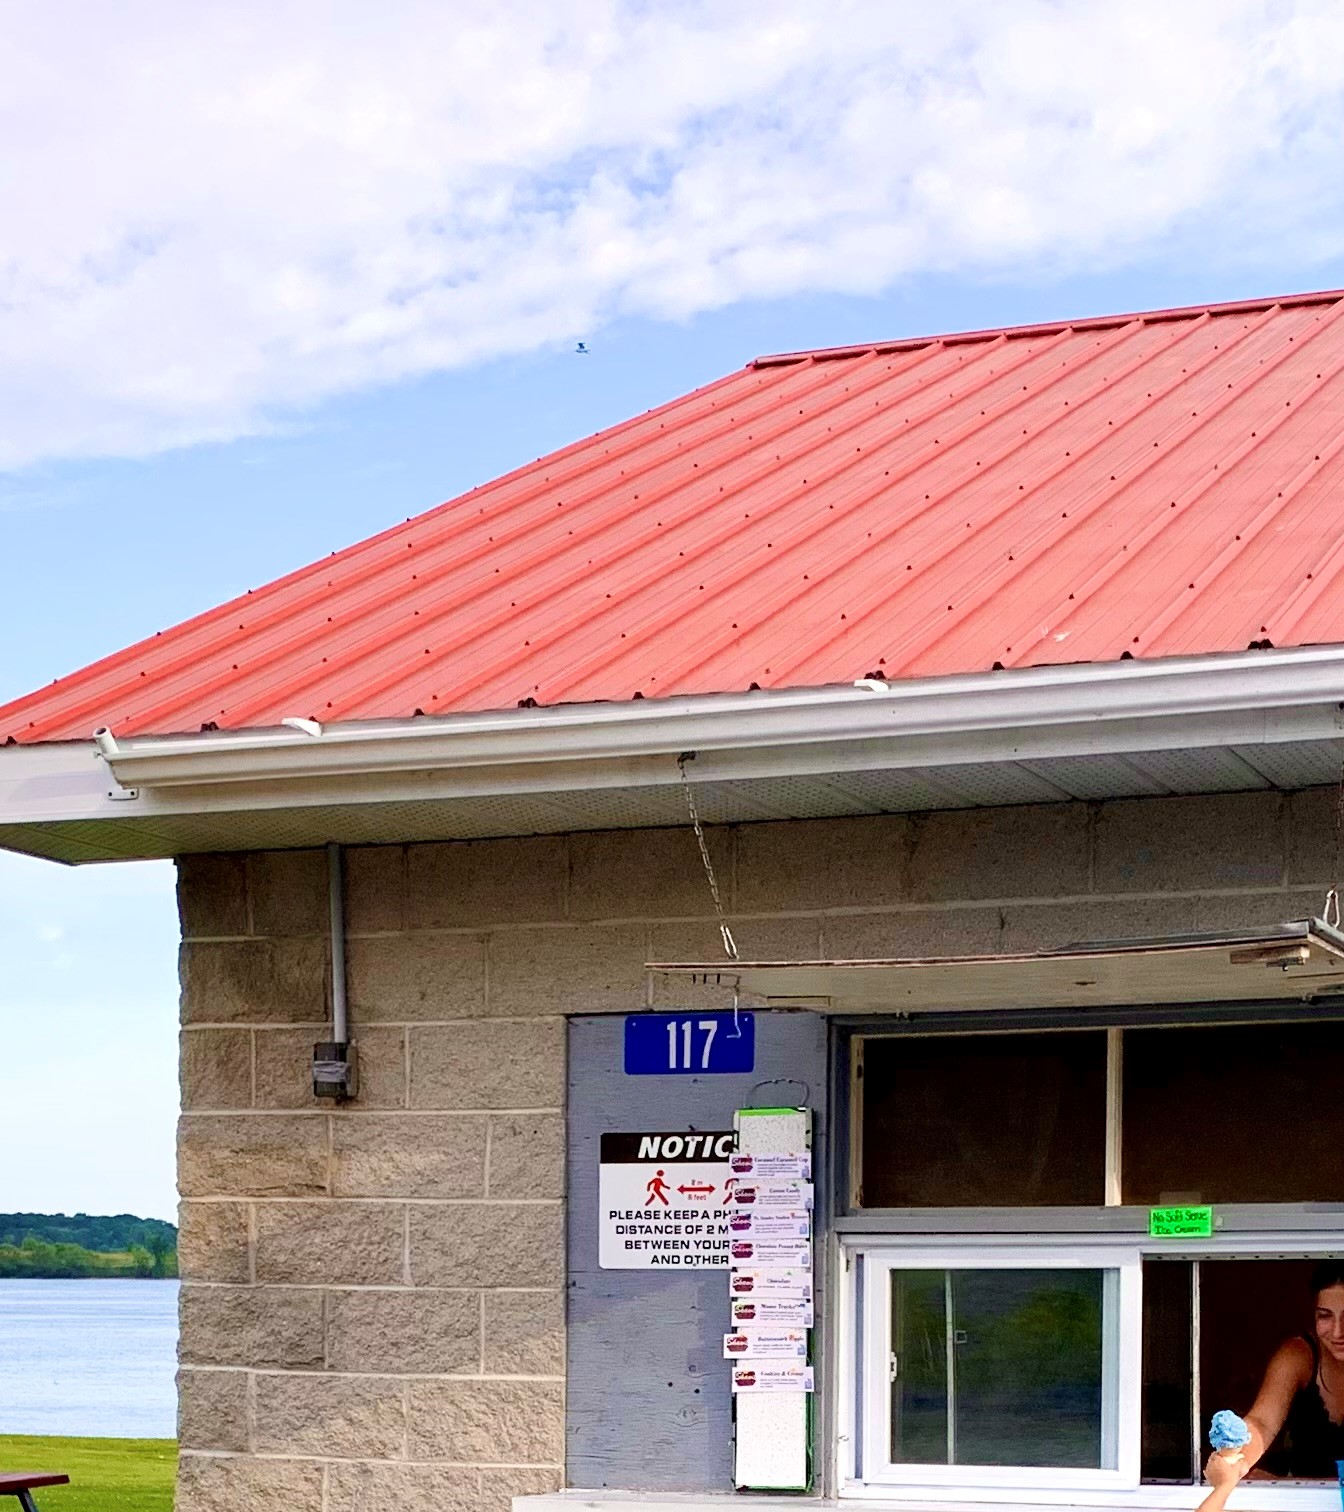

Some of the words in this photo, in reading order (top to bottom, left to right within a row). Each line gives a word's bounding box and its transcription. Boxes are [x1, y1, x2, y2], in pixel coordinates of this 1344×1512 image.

[666, 1020, 718, 1069] 117
[637, 1135, 739, 1159] NOTIC
[609, 1210, 661, 1220] PLEASE
[663, 1210, 699, 1220] KEEP
[701, 1210, 711, 1220] A
[616, 1225, 682, 1235] DISTANCE
[684, 1225, 703, 1234] OF
[706, 1225, 715, 1235] 2
[1155, 1225, 1172, 1234] Ice
[624, 1240, 690, 1250] BETWEEN
[651, 1255, 681, 1264] AND
